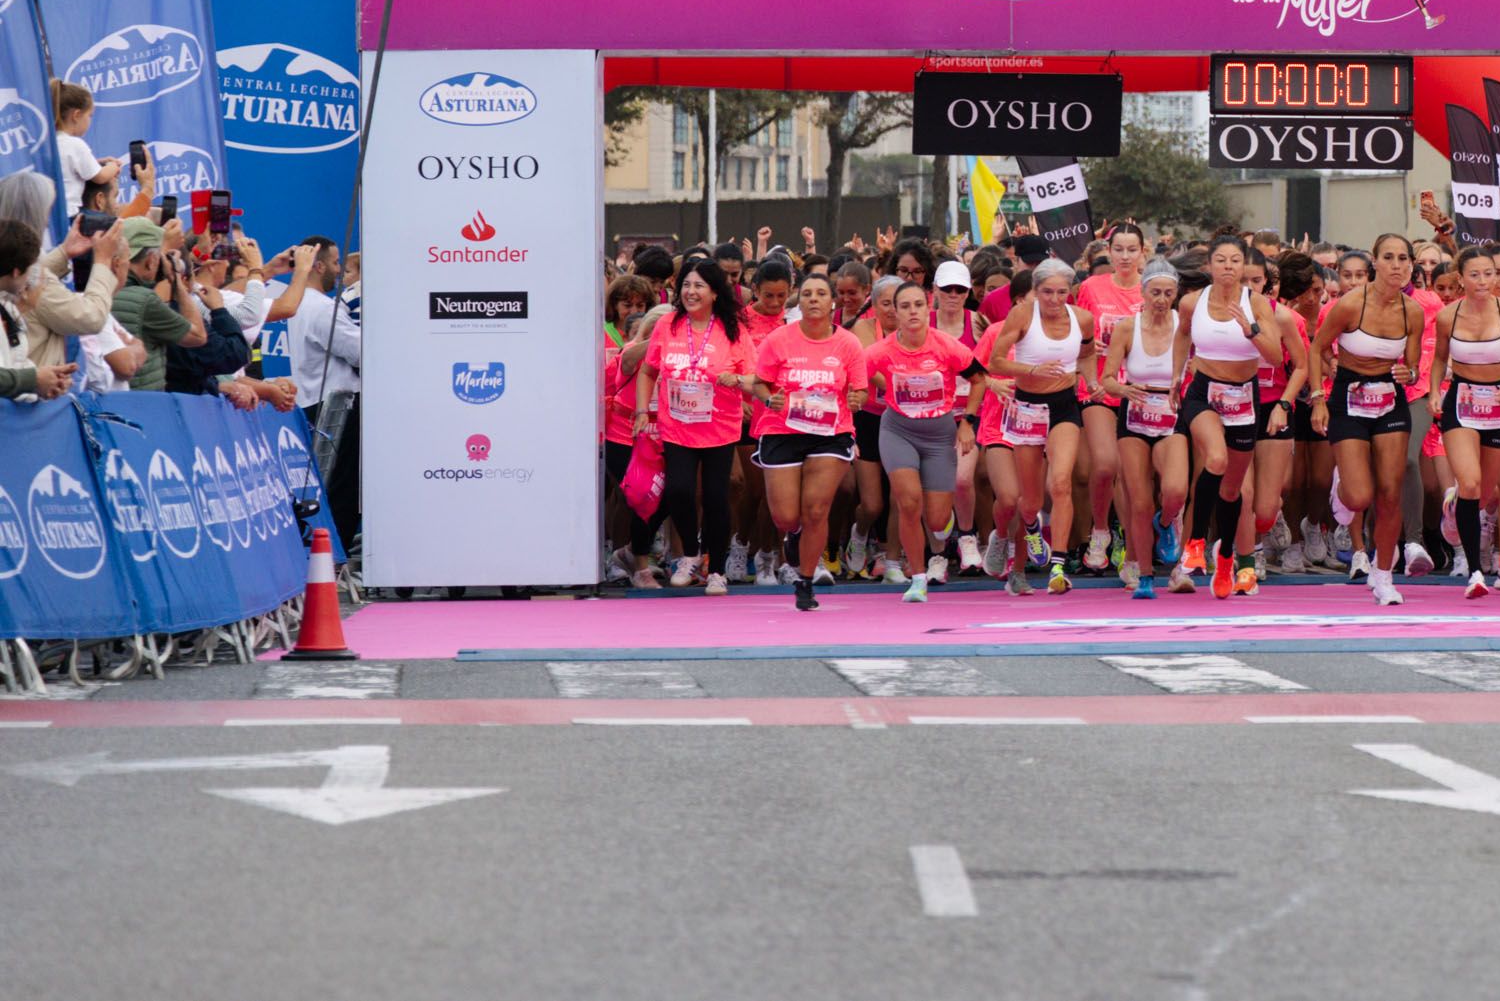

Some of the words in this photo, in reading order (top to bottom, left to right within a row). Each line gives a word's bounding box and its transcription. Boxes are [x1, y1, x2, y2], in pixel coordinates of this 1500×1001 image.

[929, 57, 1043, 69] sportssantander.es
[217, 76, 282, 92] ENTRAL
[290, 83, 355, 99] LECHERA
[428, 92, 528, 112] ASTURIANA
[219, 92, 356, 131] TURIANA
[947, 98, 1093, 132] OYSHO
[1219, 124, 1403, 164] OYSHO
[418, 155, 539, 180] OYSHO
[428, 246, 529, 263] Santander
[435, 297, 522, 319] Neutrogena
[665, 353, 708, 367] CARRRA
[455, 371, 502, 393] Marlene
[788, 370, 835, 385] CARRERA
[1364, 394, 1382, 403] 016
[805, 409, 824, 419] 016
[1143, 412, 1162, 422] 016
[1473, 405, 1492, 414] 016
[423, 468, 483, 482] octopus
[485, 467, 535, 483] energy
